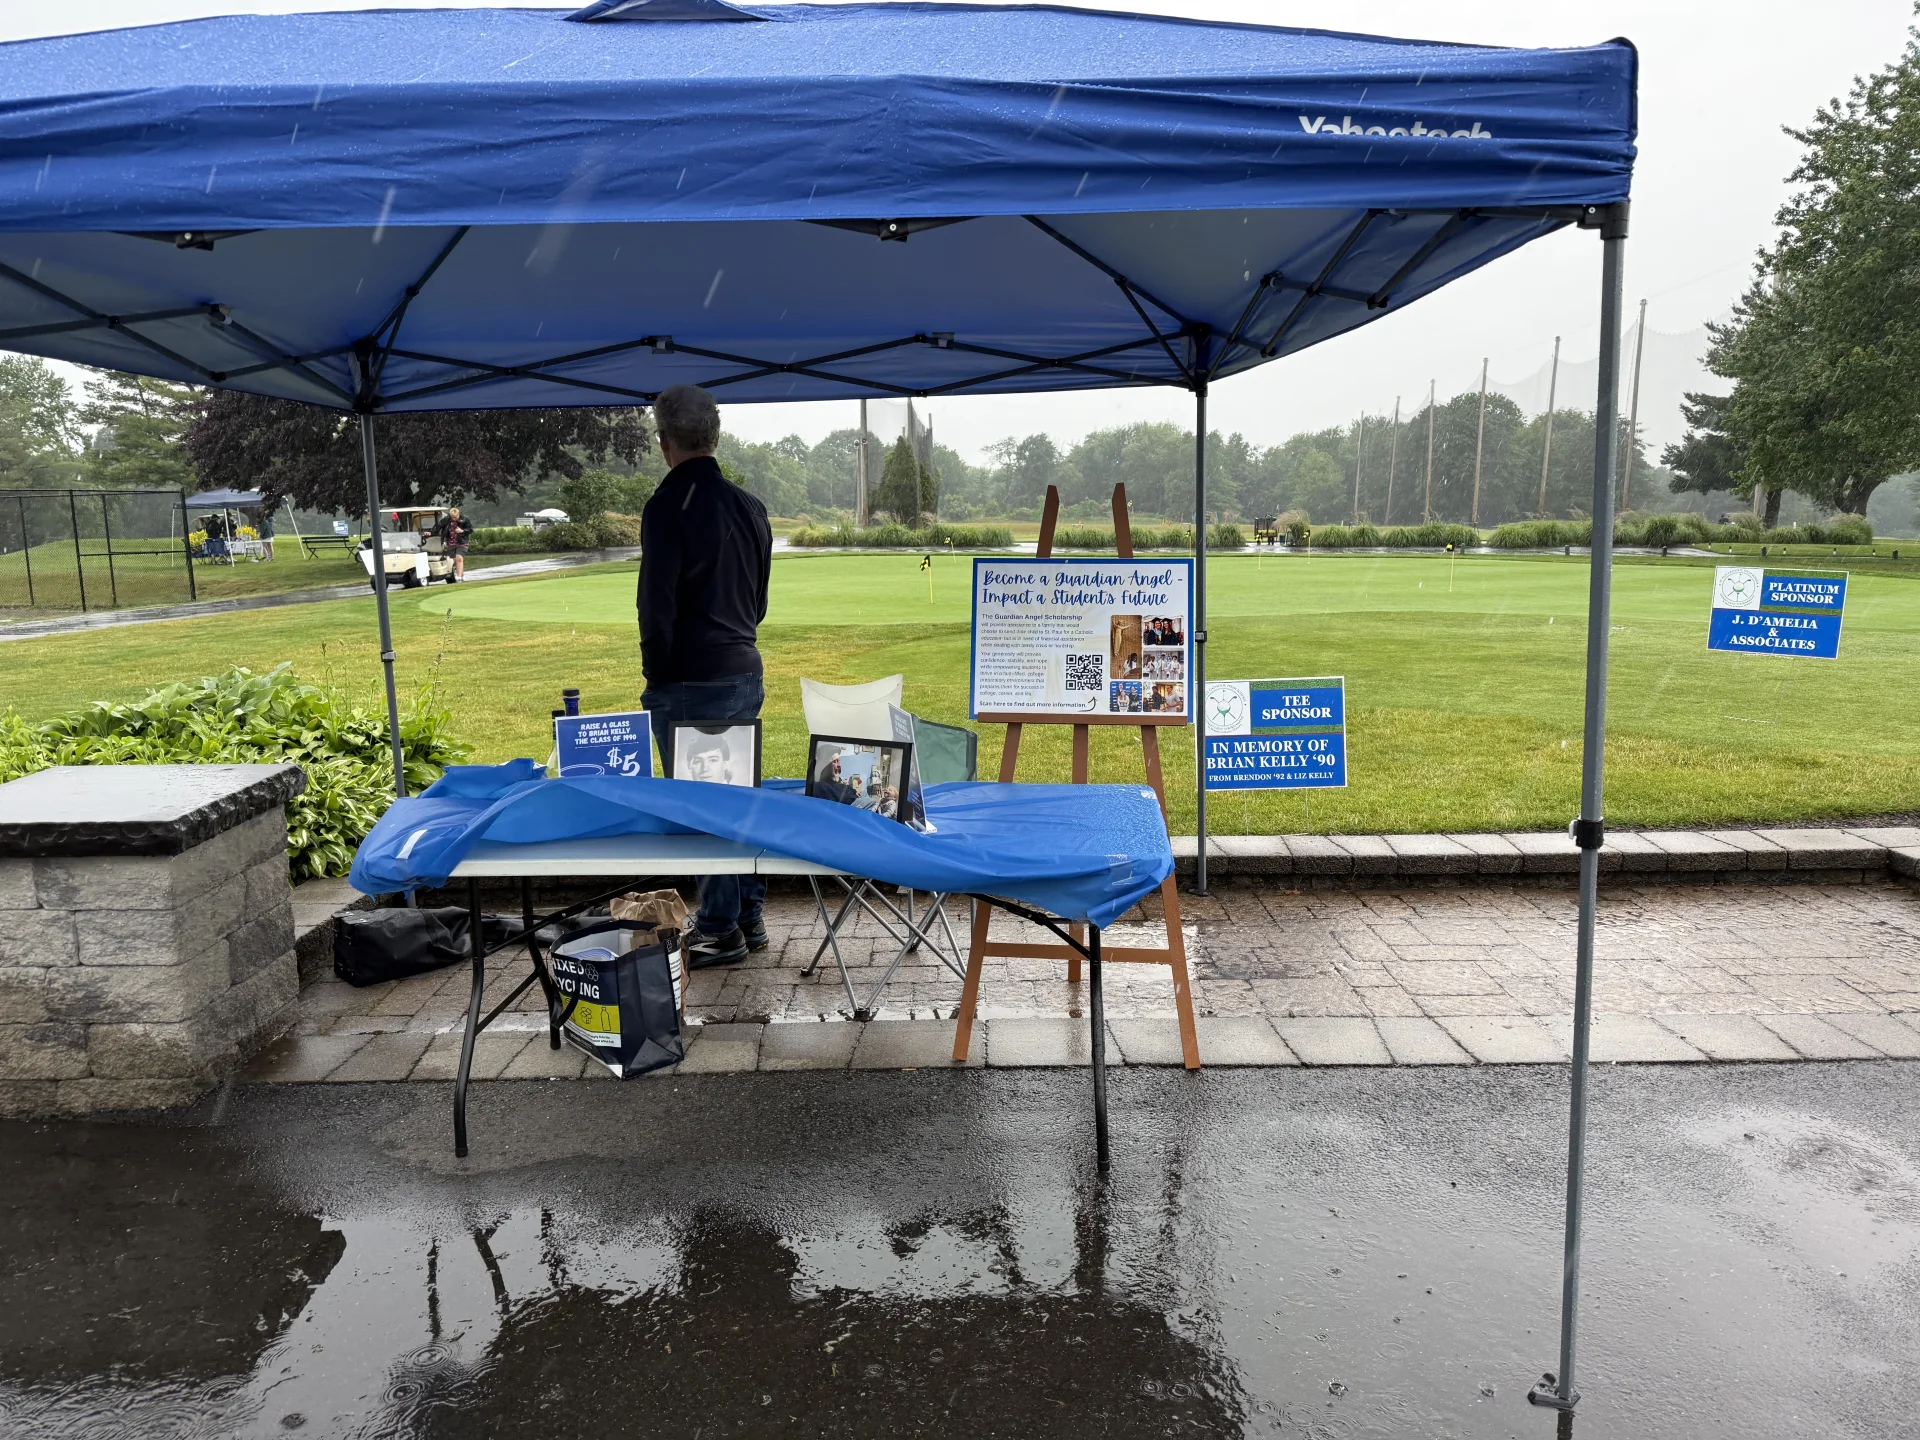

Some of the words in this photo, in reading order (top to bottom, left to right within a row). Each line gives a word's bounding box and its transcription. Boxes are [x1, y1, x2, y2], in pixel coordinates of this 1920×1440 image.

[983, 570, 1036, 586] Become
[1040, 574, 1050, 586] a
[1055, 571, 1126, 587] Guardian
[1128, 569, 1173, 588] Angel
[1769, 582, 1839, 595] PLATINUM
[982, 588, 1034, 607] Impact
[1037, 593, 1047, 604] a
[1050, 589, 1116, 606] Student's
[1122, 590, 1169, 606] Future
[1771, 592, 1834, 604] SPONSOR
[1732, 615, 1744, 625] J.
[1748, 616, 1818, 629] D'AMELIA
[1768, 627, 1779, 637] &
[1729, 635, 1815, 650] ASSOCIATES
[1282, 695, 1310, 707] TEE
[1262, 707, 1332, 720] SPONSOR
[1212, 742, 1230, 754] IN
[1233, 740, 1304, 754] MEMORY
[1308, 739, 1328, 751] OF
[604, 746, 640, 776] $5
[1206, 756, 1255, 769] BRIAN
[1260, 755, 1309, 768] KELLY
[1209, 774, 1231, 782] FROM
